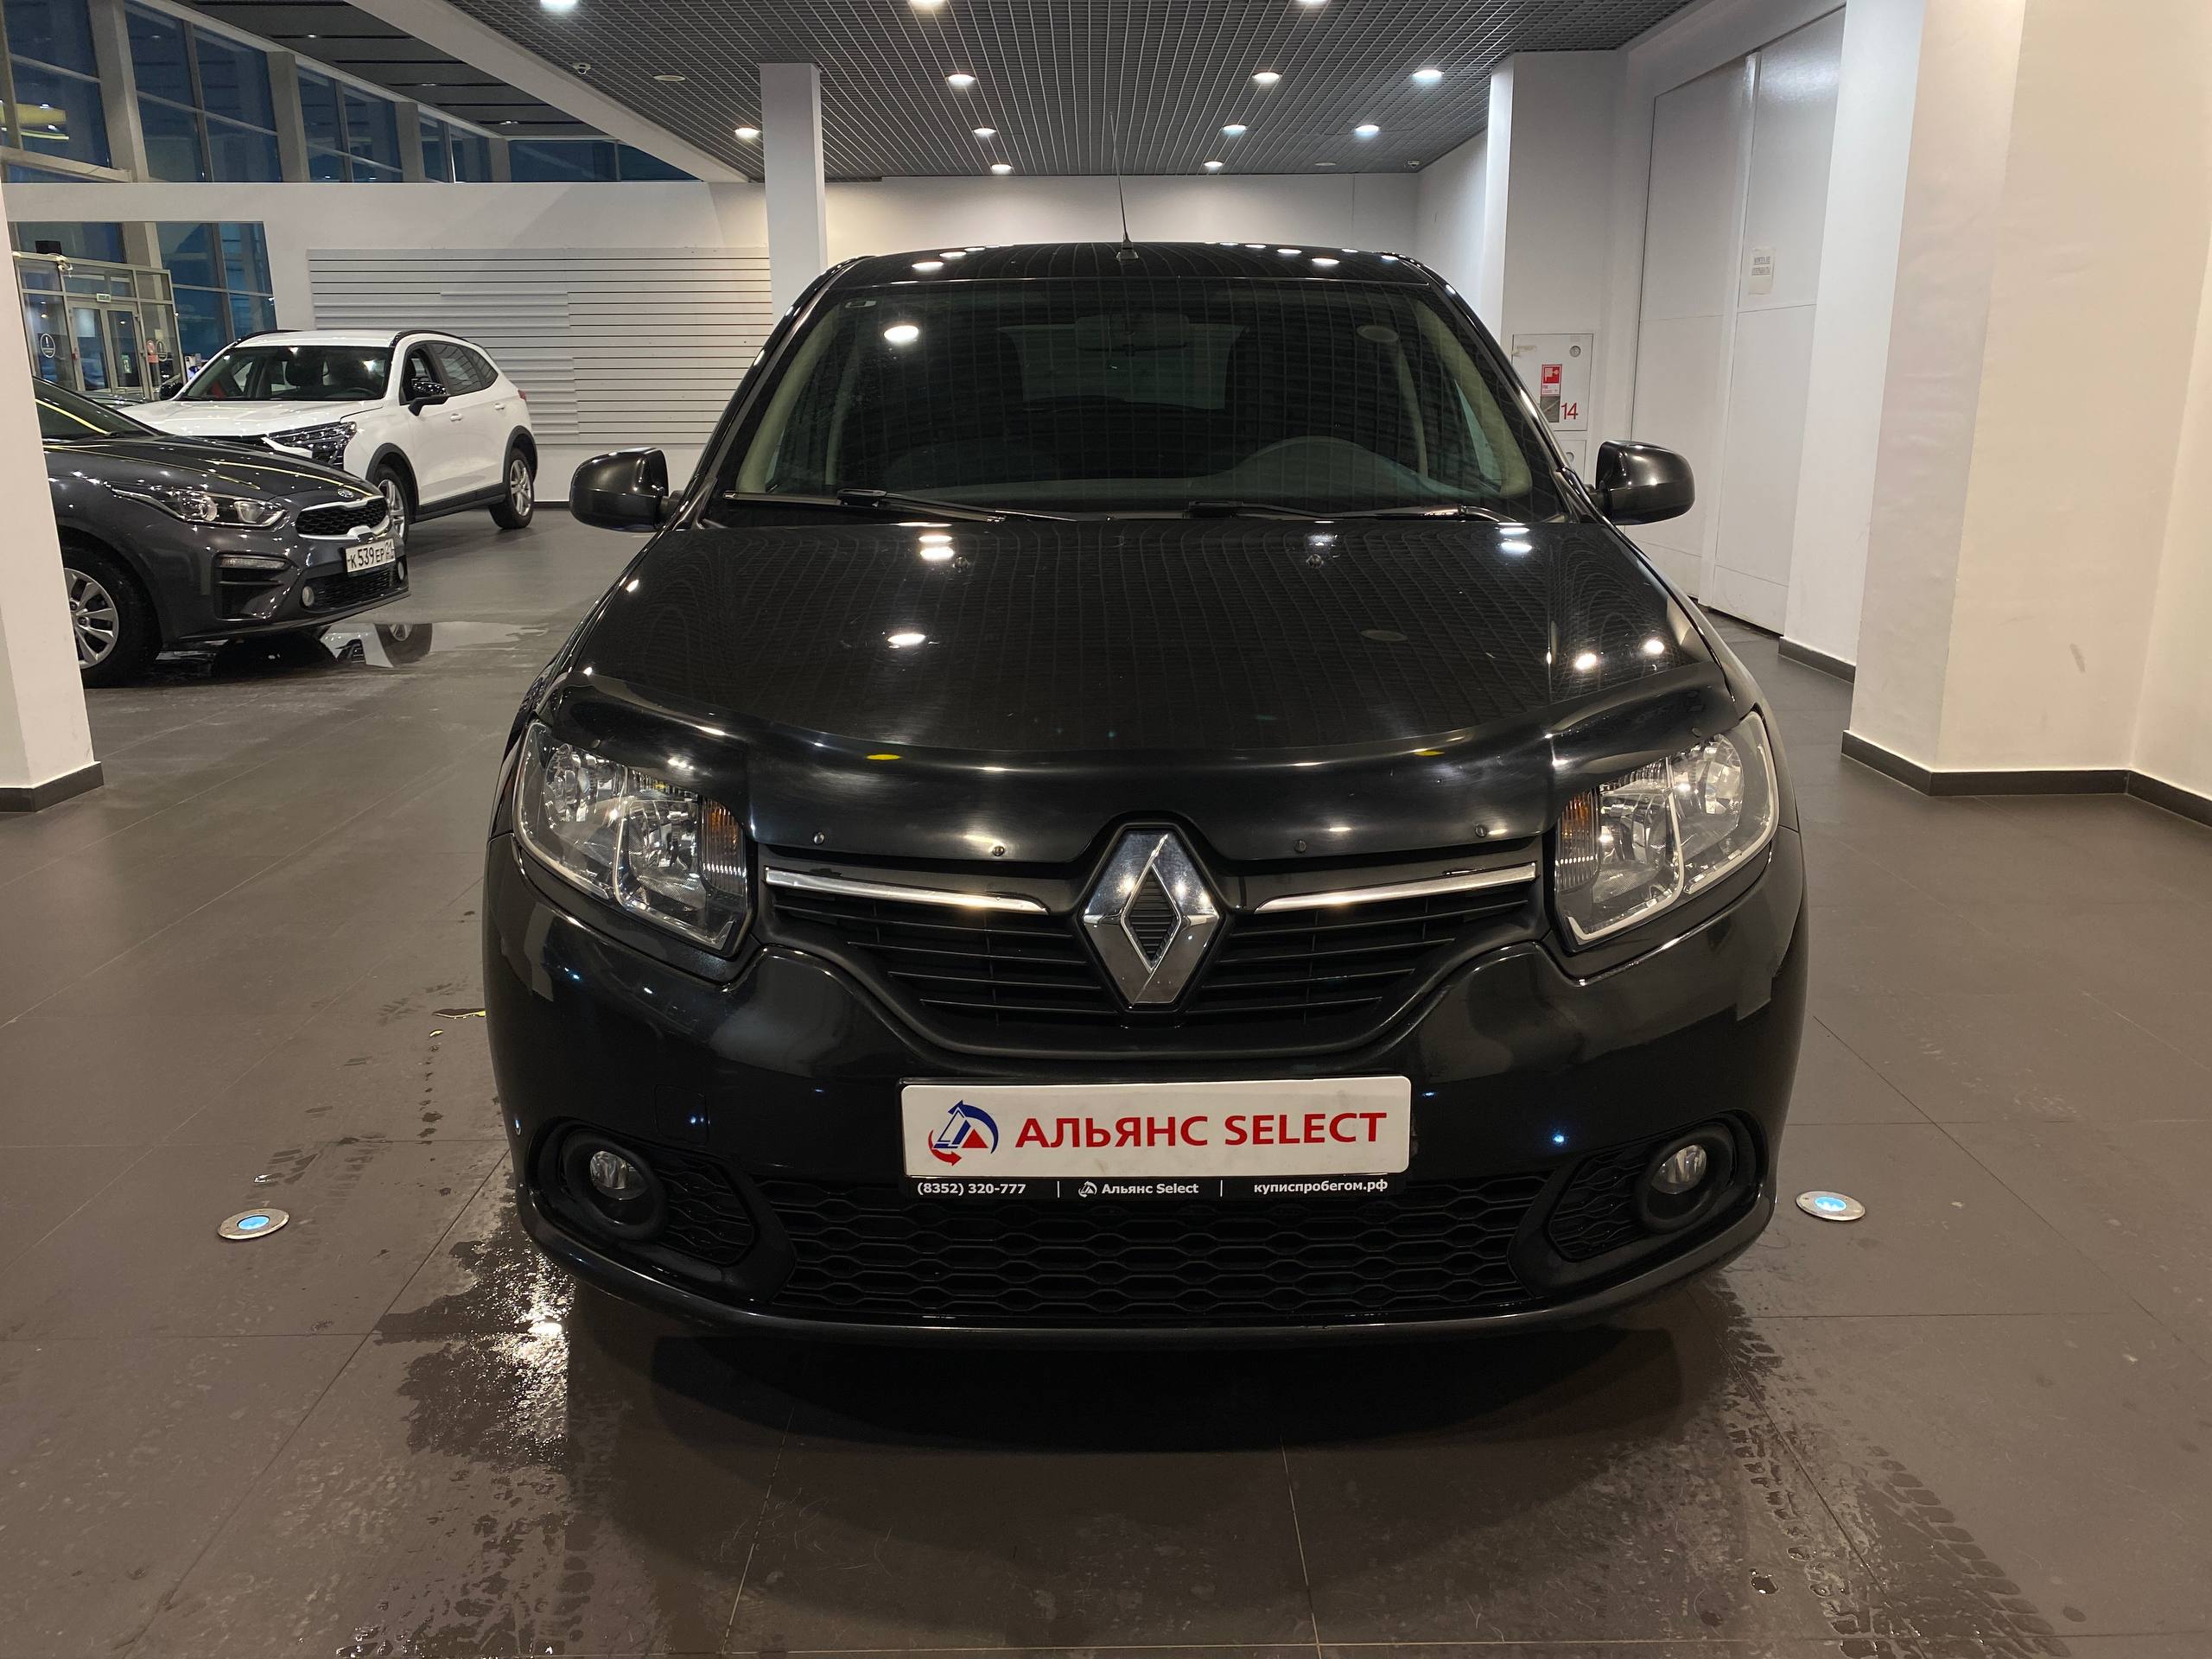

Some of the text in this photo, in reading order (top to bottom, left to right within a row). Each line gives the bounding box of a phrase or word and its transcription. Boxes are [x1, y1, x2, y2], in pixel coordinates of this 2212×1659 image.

[1561, 402, 1579, 420] 14
[1014, 1112, 1388, 1148] АЛЬЯНС SELECT
[917, 1181, 1027, 1197] (8352) 320-777
[1101, 1183, 1199, 1194] Альянс Select
[1253, 1179, 1389, 1195] куписпробегом.рф
